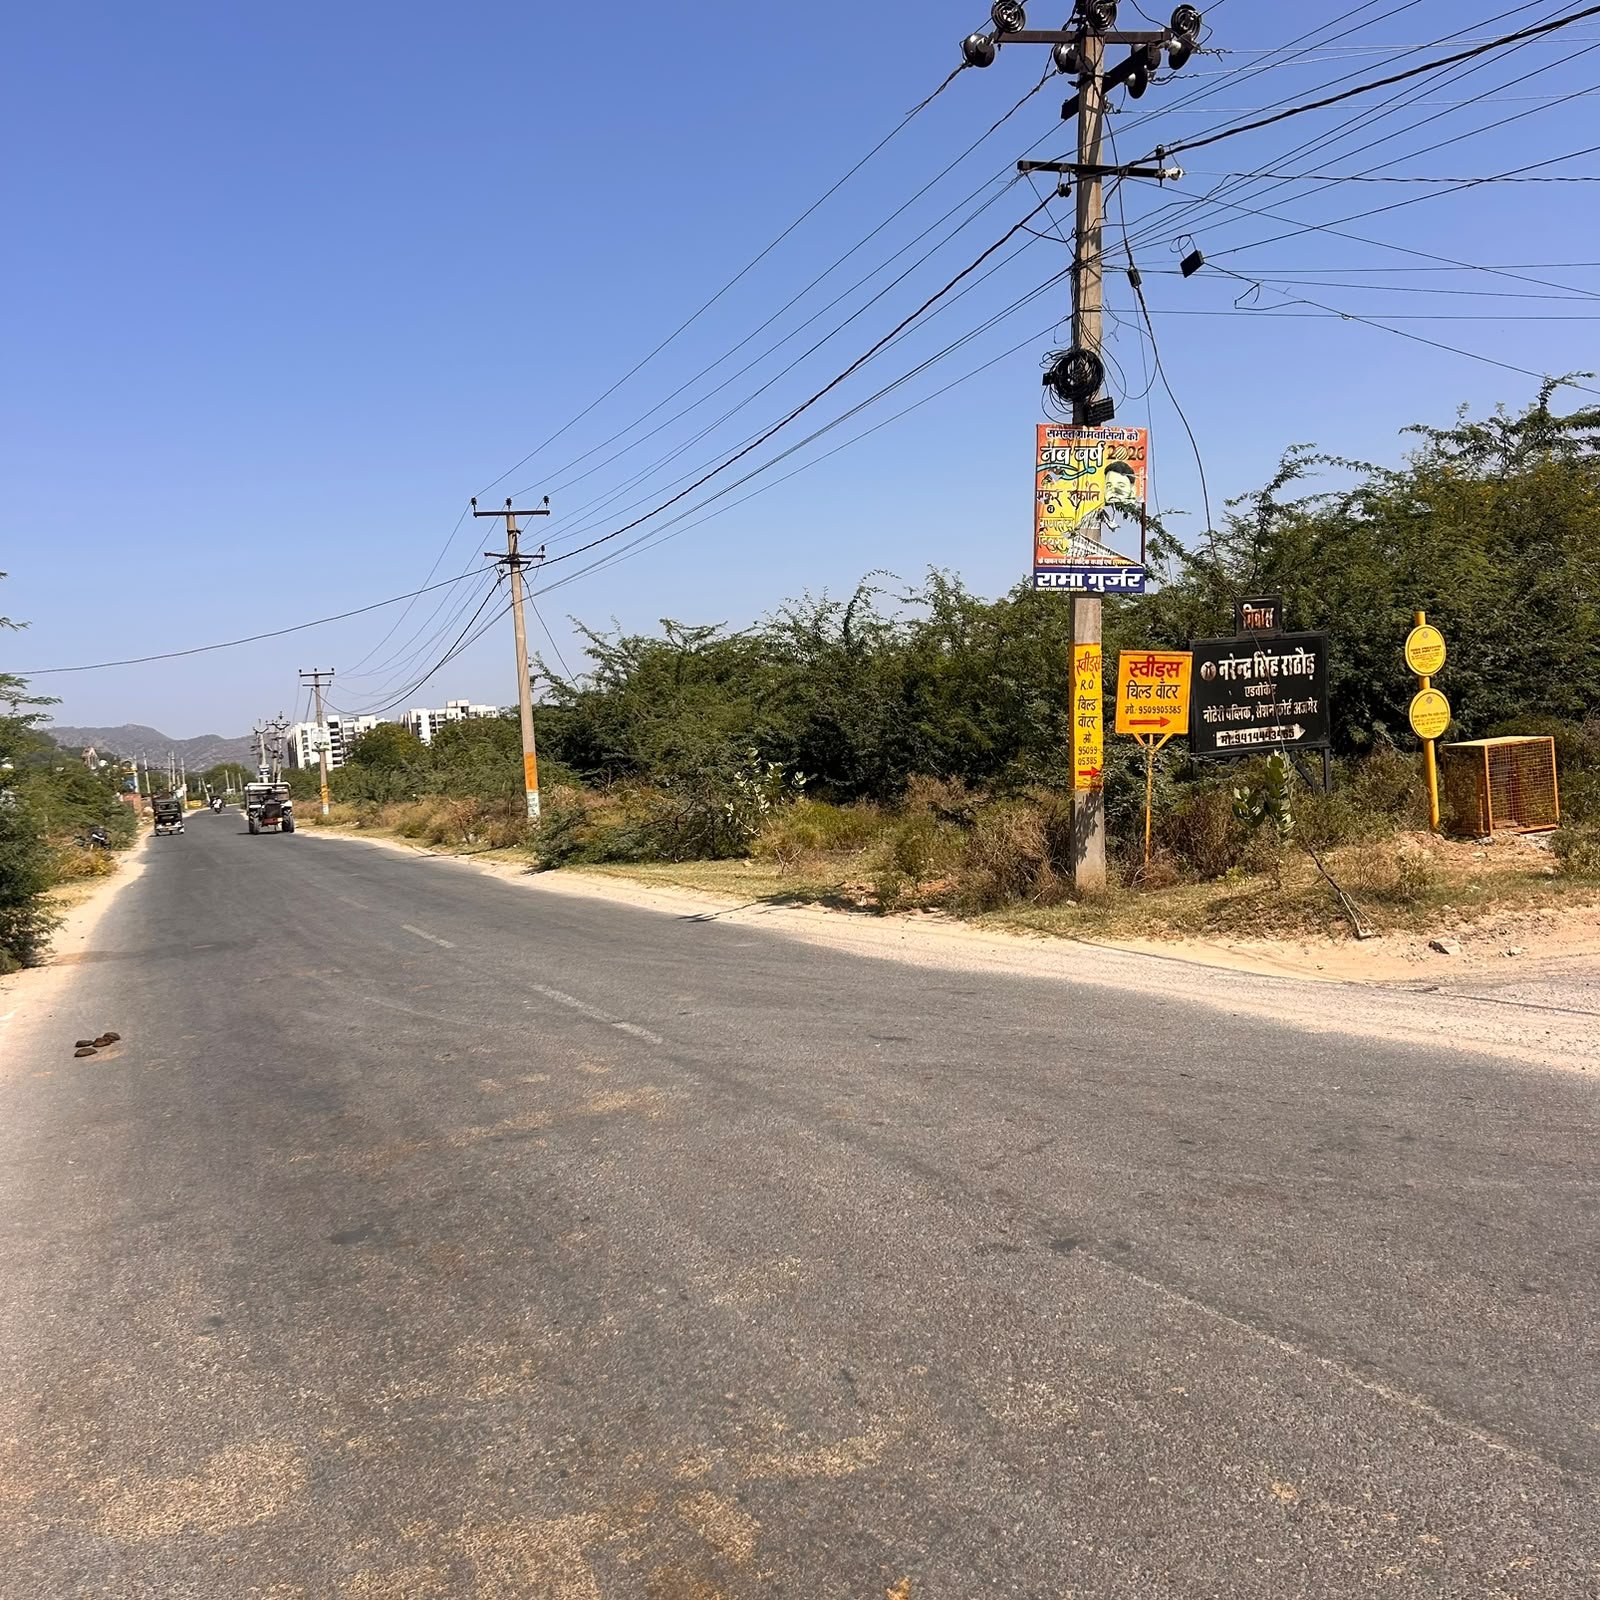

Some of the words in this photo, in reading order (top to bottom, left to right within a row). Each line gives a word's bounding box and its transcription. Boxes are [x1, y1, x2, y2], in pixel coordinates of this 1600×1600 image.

[1126, 430, 1139, 441] को
[1041, 446, 1071, 465] नव
[1075, 440, 1106, 467] वर्ष
[1107, 444, 1146, 461] 2026
[1036, 572, 1085, 587] रामा
[1087, 568, 1144, 593] गुर्जर
[1218, 652, 1253, 681] नरेन्द्र
[1253, 648, 1280, 679] सिंह
[1126, 679, 1153, 700] चिल्ड
